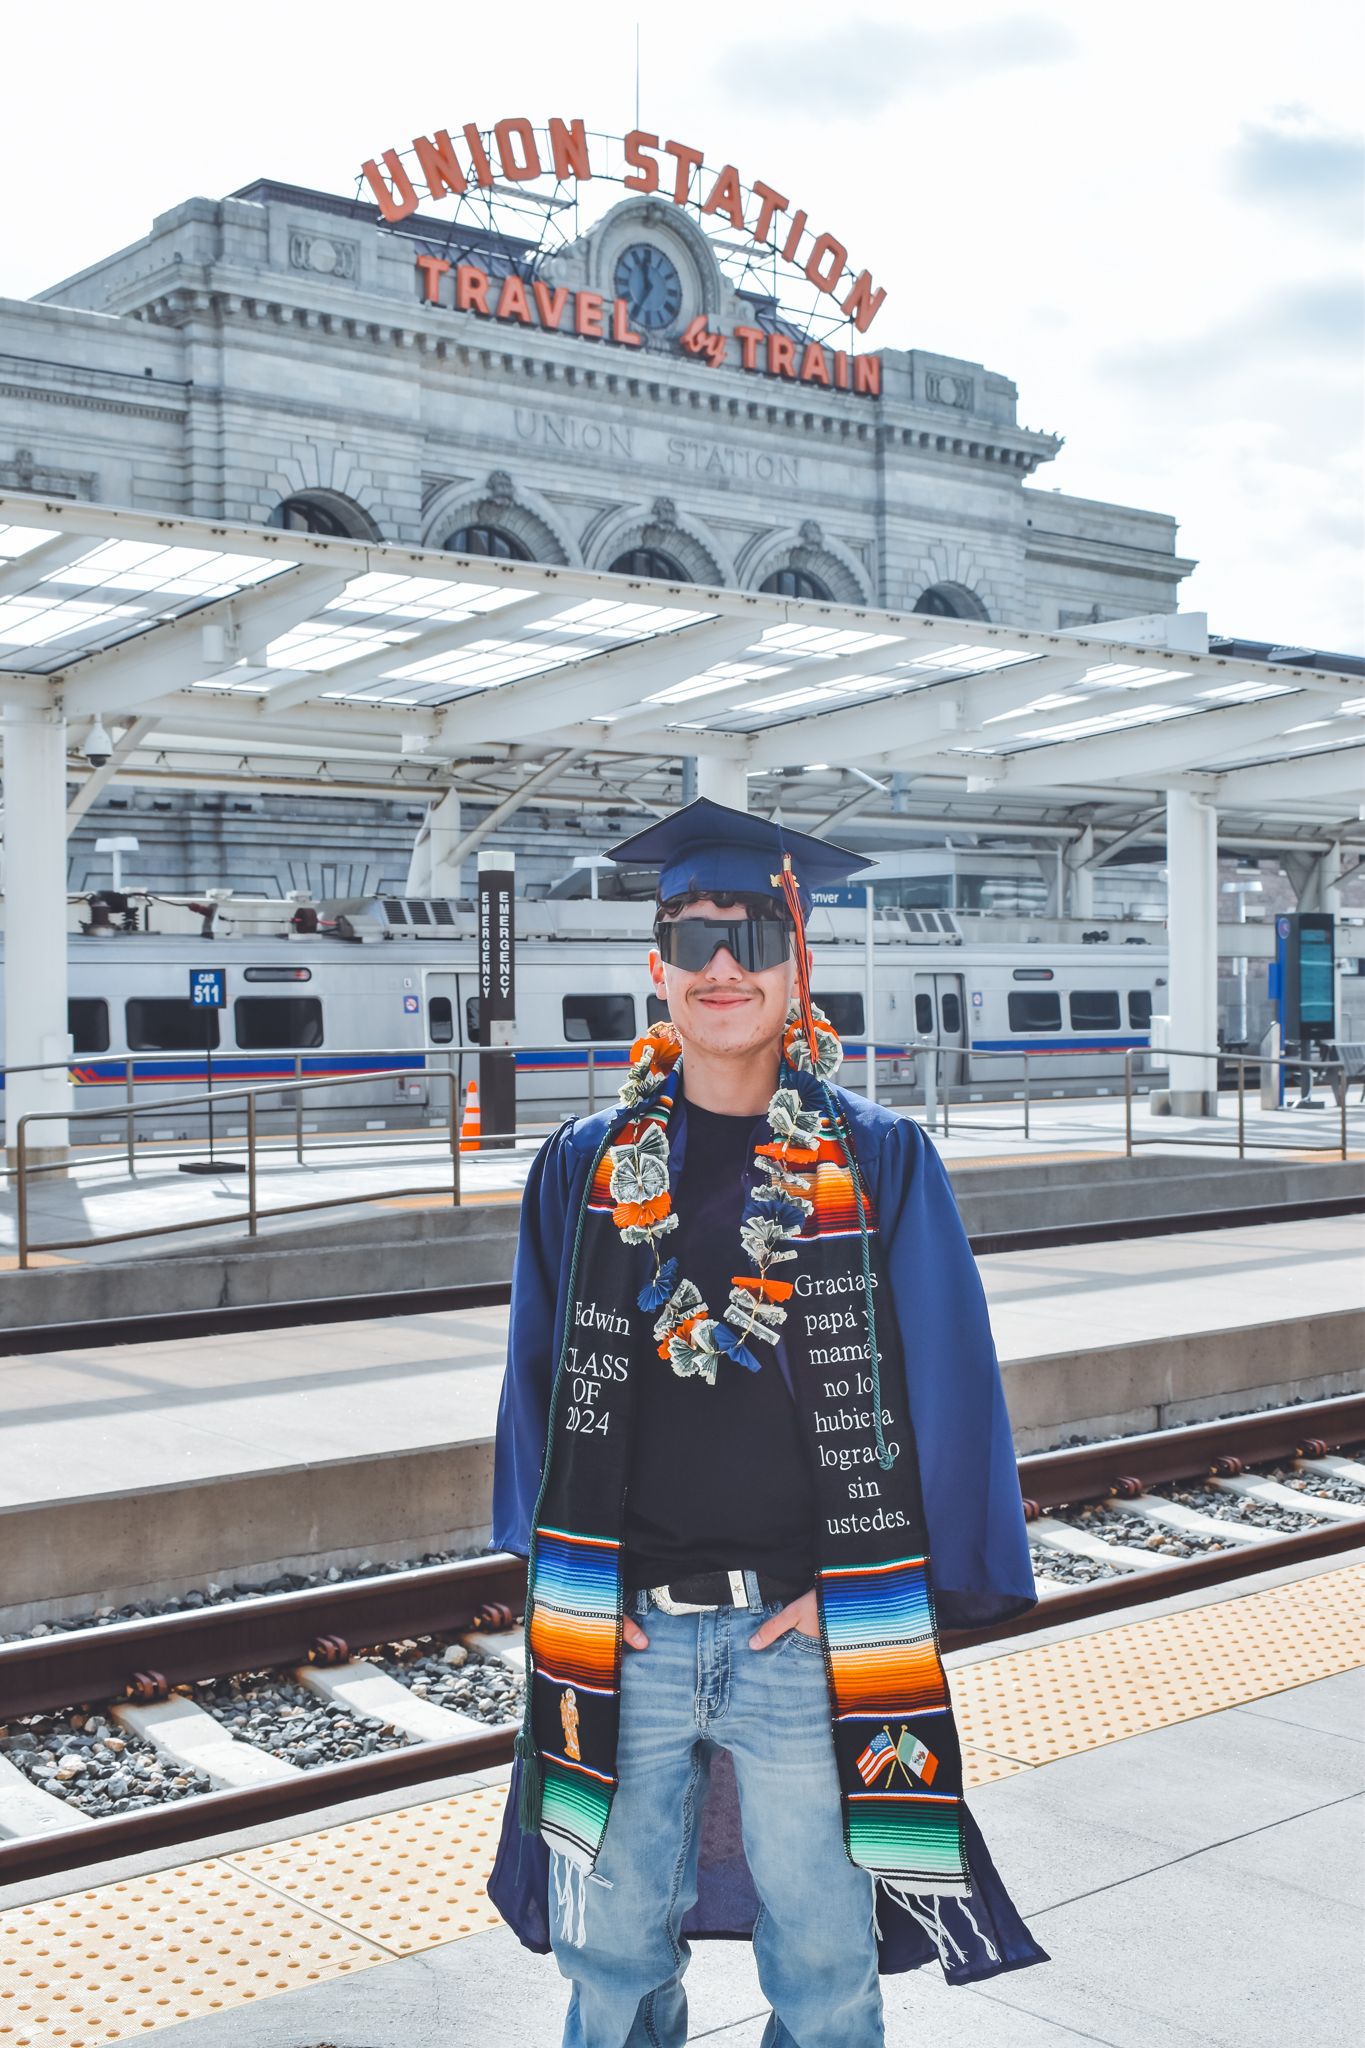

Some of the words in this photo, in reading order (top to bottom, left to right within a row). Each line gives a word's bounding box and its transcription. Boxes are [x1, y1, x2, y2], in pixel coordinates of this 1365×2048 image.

[362, 117, 592, 223] UNION
[624, 130, 887, 333] STATION
[416, 255, 642, 345] TRAVEL
[680, 314, 728, 368] by
[735, 326, 882, 396] TRAIN
[513, 408, 634, 459] UNION
[667, 437, 800, 486] STATION
[481, 891, 491, 999] EMERGENCY
[499, 891, 510, 999] EMERGENCY
[194, 984, 219, 1003] 511
[198, 973, 215, 984] CAR
[794, 1270, 879, 1297] Gracias
[574, 1301, 631, 1336] Edwin
[804, 1304, 858, 1337] papá
[565, 1347, 630, 1382] CLASS
[573, 1377, 602, 1405] OF
[823, 1380, 850, 1398] no
[855, 1372, 874, 1395] lo
[565, 1406, 610, 1436] 2024
[847, 1476, 882, 1499] sin
[826, 1507, 911, 1535] ustedes.
